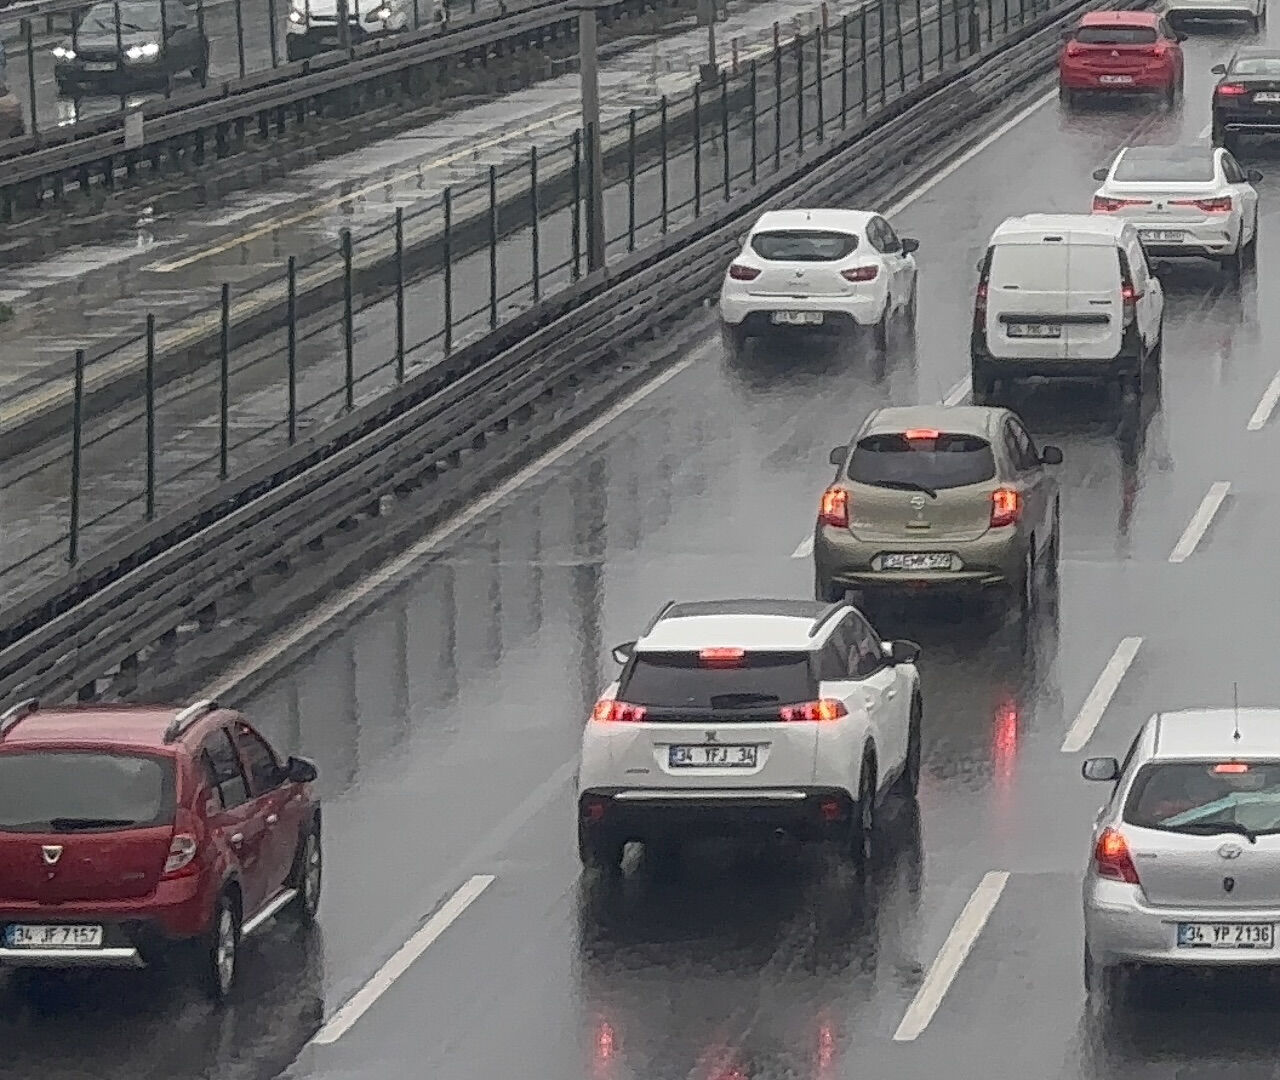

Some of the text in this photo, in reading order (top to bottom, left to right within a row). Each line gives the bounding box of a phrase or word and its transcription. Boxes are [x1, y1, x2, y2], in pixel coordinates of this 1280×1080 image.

[677, 749, 693, 763] 34
[738, 749, 754, 763] 34
[16, 927, 34, 942] 34
[62, 926, 100, 942] 7157
[1187, 925, 1270, 942] 34 YP 2136
